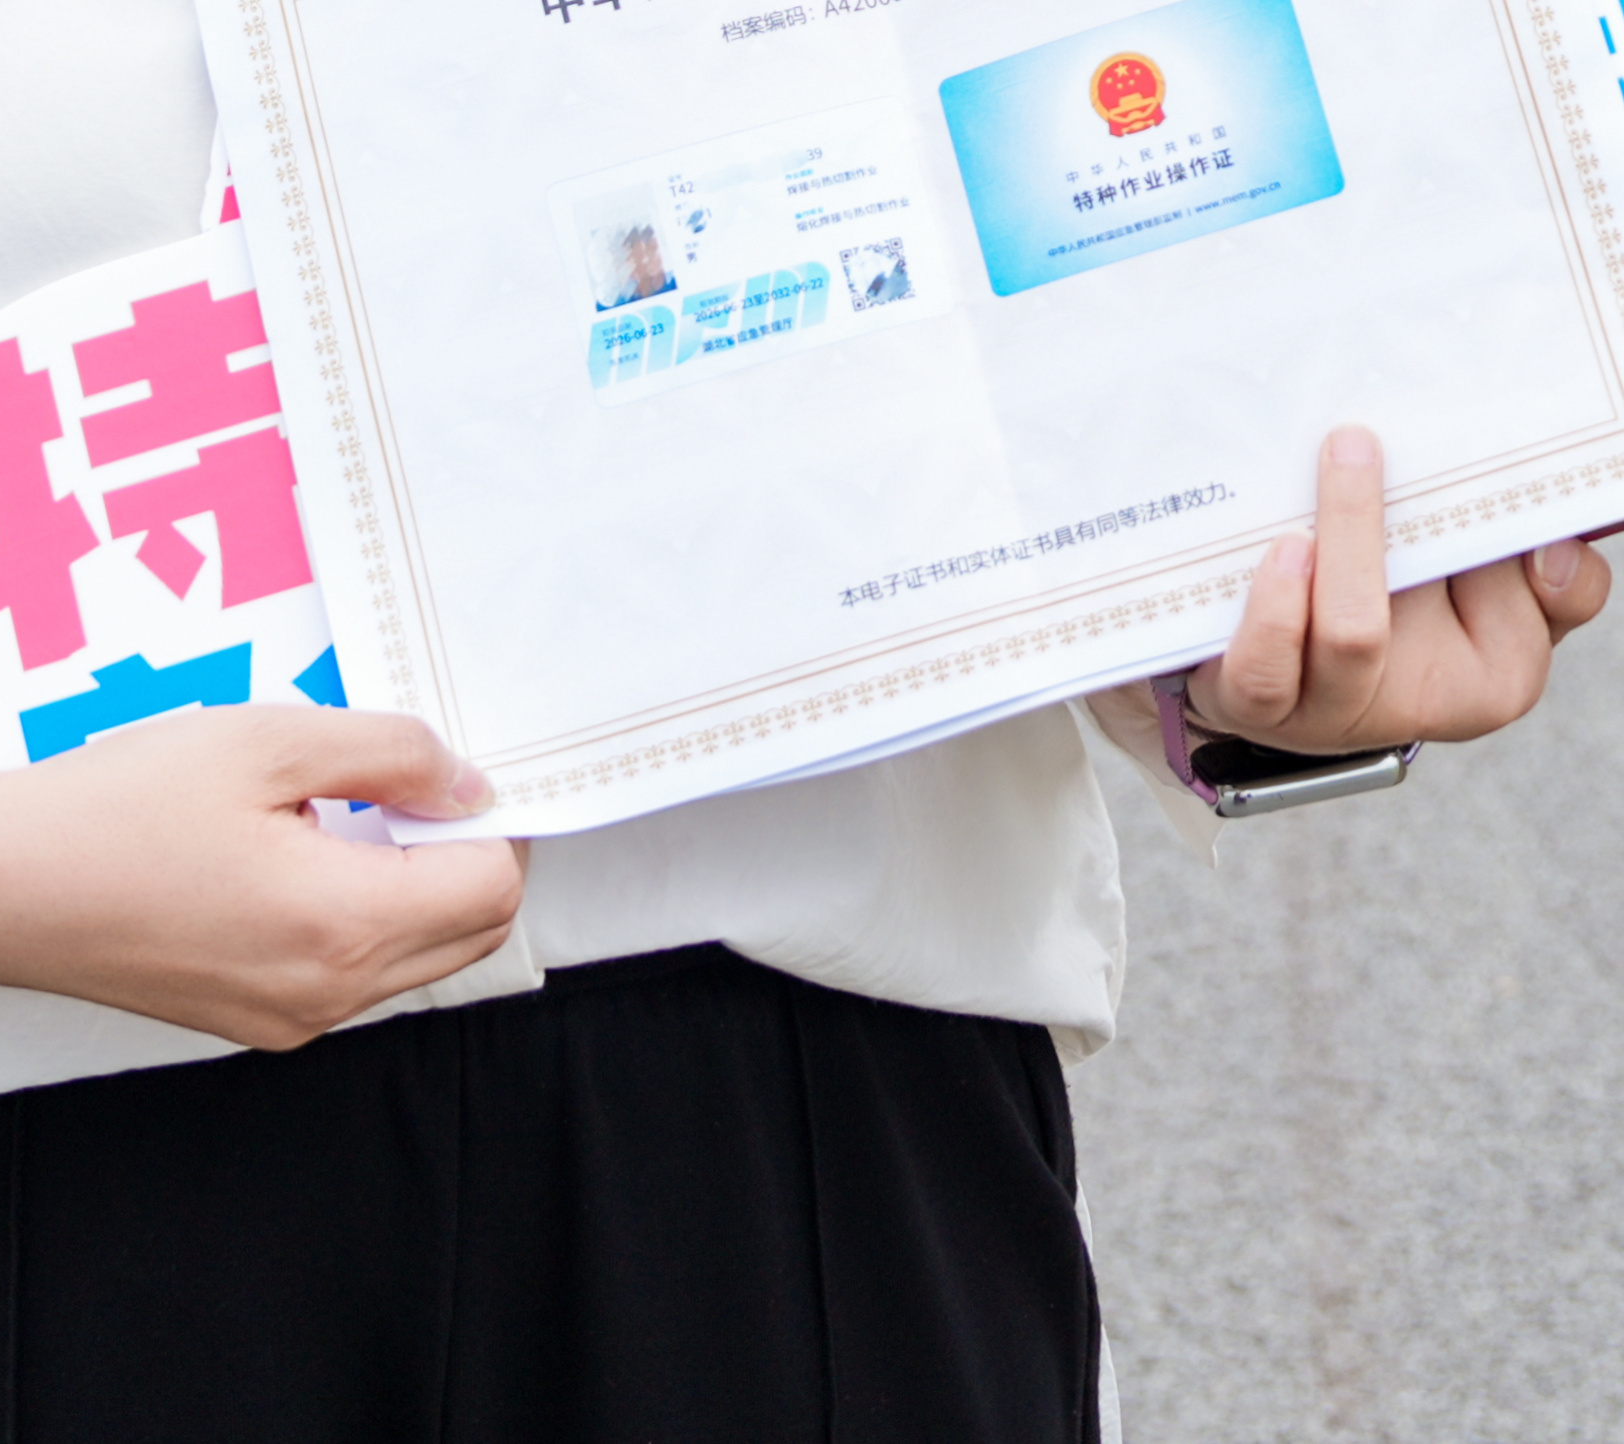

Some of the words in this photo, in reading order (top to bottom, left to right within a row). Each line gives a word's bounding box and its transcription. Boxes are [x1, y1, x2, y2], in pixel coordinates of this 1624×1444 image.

[1066, 125, 1227, 184] 中华人民共和国
[1073, 148, 1234, 212] 特种作业操作证
[1195, 181, 1281, 213] www.mem.gov.cn
[838, 480, 1237, 609] 本电子证书和实体证书具有同等法律效力。
